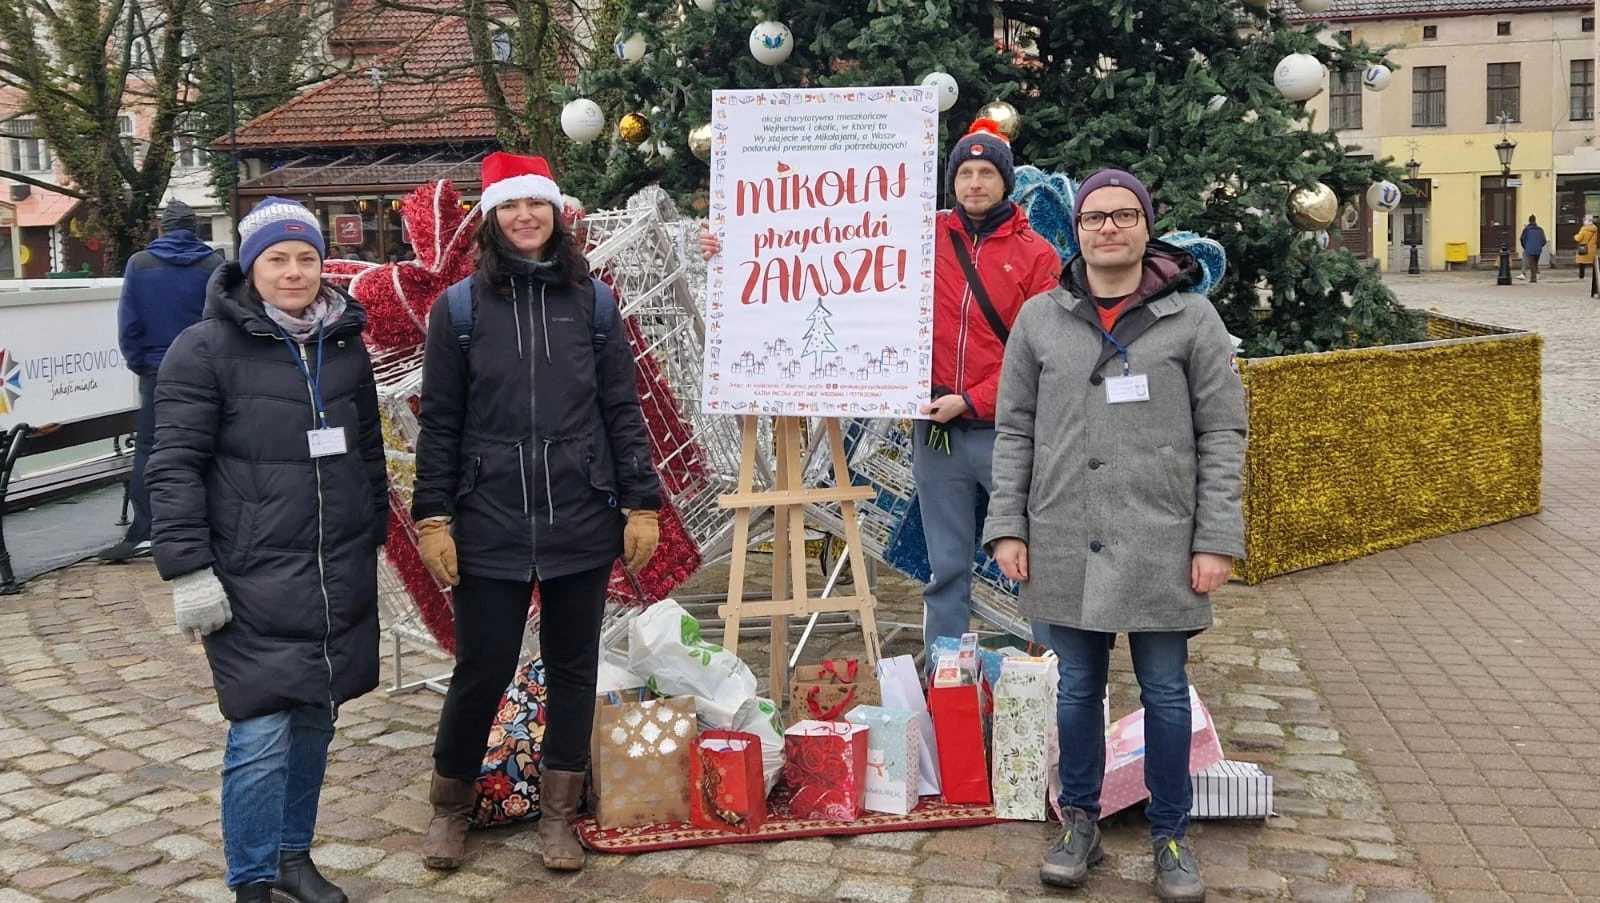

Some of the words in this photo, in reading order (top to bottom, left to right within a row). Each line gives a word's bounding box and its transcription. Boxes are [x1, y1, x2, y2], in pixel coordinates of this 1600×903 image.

[761, 114, 782, 123] akcja
[783, 113, 834, 123] charytatywna
[763, 124, 805, 133] Wejherowa
[851, 122, 876, 131] której
[878, 122, 888, 130] to
[753, 134, 766, 143] Wy
[768, 134, 799, 143] stajecie
[801, 133, 812, 143] się
[871, 131, 896, 140] Wasze
[741, 144, 780, 153] podarunki
[782, 143, 827, 153] prezentami
[829, 142, 842, 151] dla
[844, 140, 908, 152] potrzebujących!
[736, 162, 909, 216] MIKOŁAJ
[754, 211, 890, 257] przychodzi
[740, 245, 907, 305] ZAWSZE!
[74, 378, 98, 392] miasta
